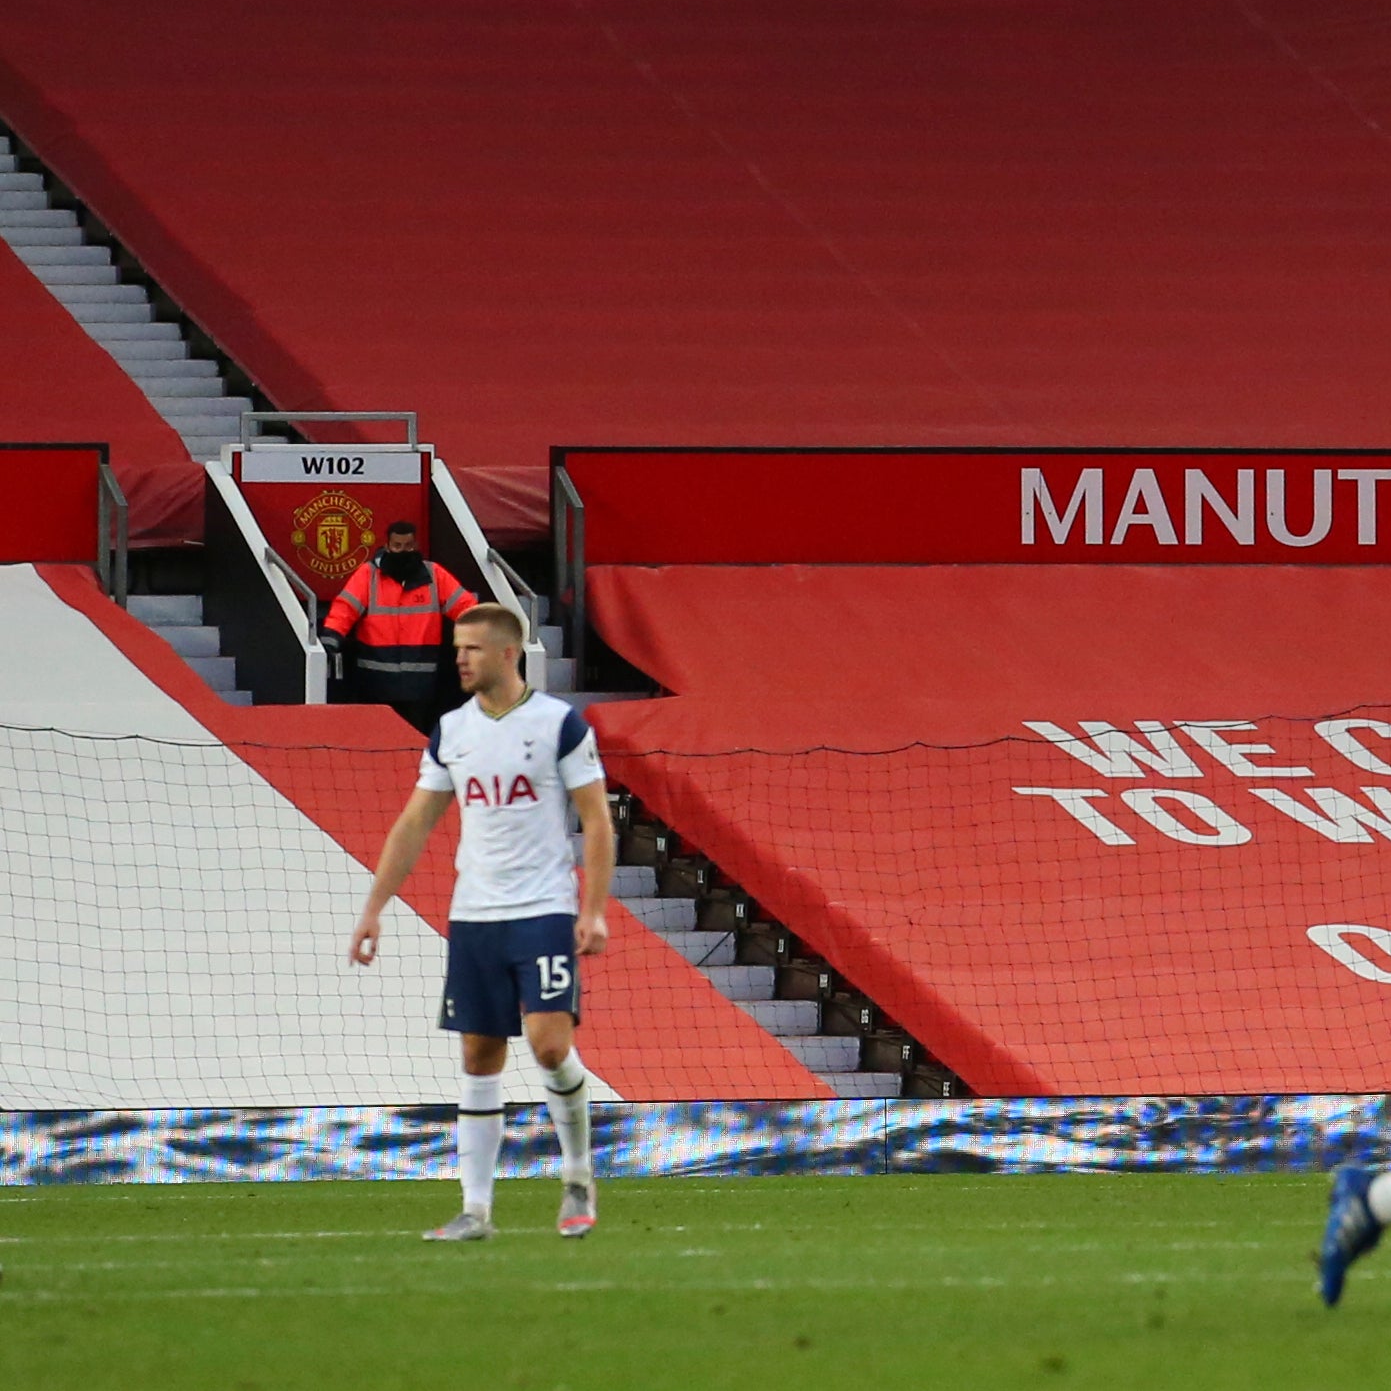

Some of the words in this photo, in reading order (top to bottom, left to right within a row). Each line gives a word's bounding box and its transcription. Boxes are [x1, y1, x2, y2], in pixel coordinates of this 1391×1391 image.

[302, 457, 365, 475] W102
[300, 496, 368, 526] MANCHESTER
[310, 558, 358, 574] UNITED
[1022, 719, 1316, 778] WE
[464, 773, 539, 807] AIA
[1012, 787, 1252, 846] TO
[536, 955, 572, 990] 15
